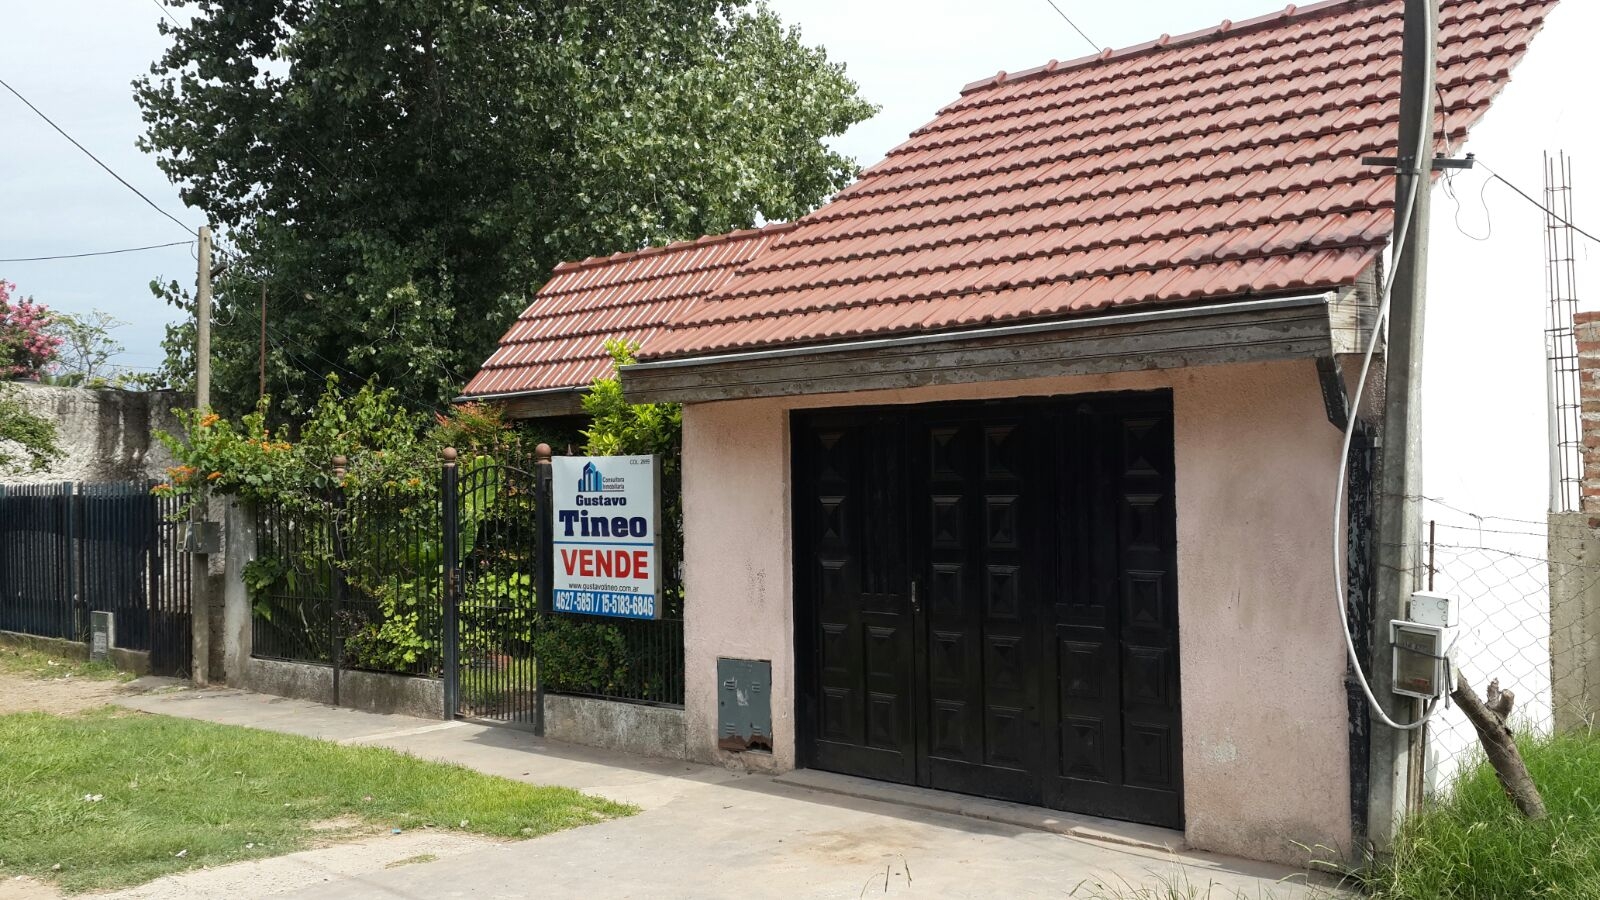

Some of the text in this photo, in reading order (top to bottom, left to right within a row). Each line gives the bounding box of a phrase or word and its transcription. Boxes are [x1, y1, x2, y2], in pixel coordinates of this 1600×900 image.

[575, 494, 627, 506] Gustavo
[558, 509, 648, 538] Tineo
[560, 549, 649, 579] VENDE
[568, 582, 640, 593] www.gustavotineo.com.ar
[555, 591, 594, 612] 4627-5851
[601, 594, 653, 617] 15-5183-6846
